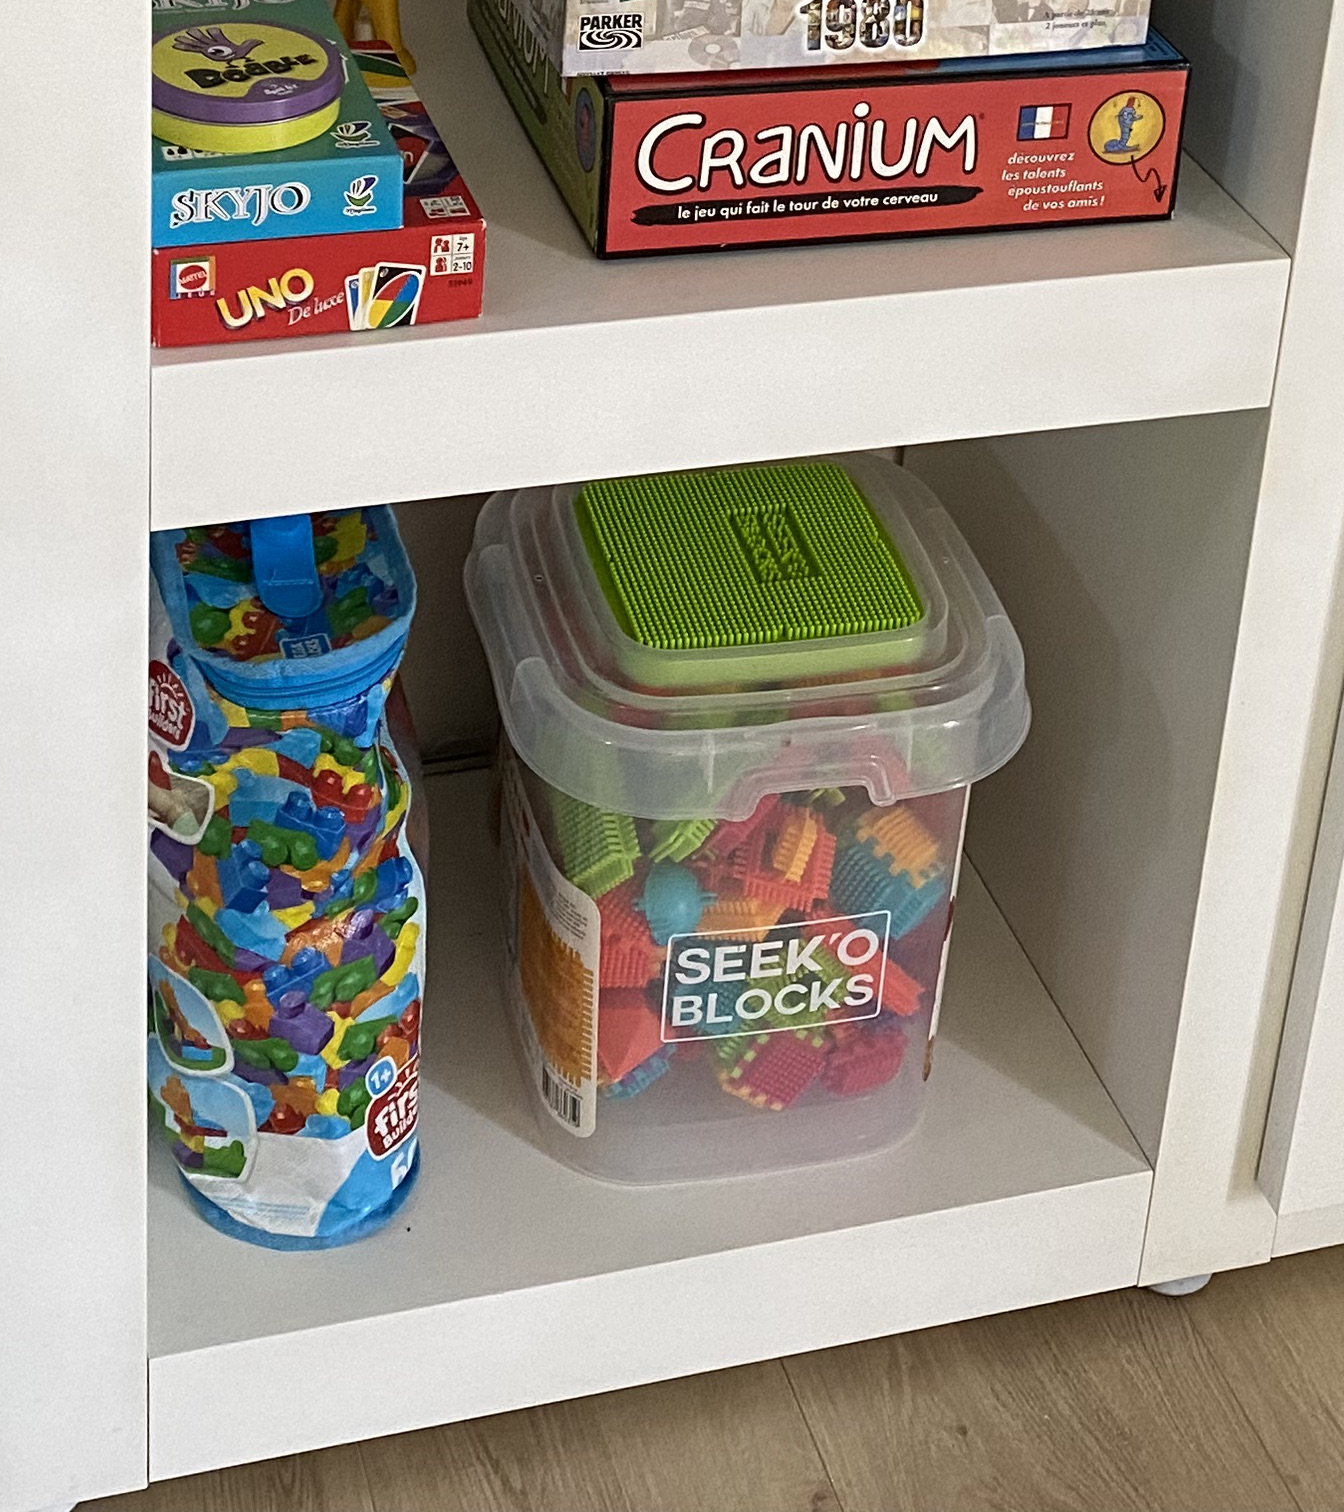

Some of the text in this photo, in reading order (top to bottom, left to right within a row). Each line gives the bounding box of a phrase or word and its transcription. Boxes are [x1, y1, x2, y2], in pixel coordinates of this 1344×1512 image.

[580, 13, 643, 31] PARKER
[1008, 151, 1076, 166] découvrez
[1001, 167, 1067, 182] les talents
[1008, 180, 1104, 199] époustouflants
[170, 182, 311, 228] SKYJO
[677, 191, 939, 222] le jeu qui fait le tour de votre cerveau
[1023, 198, 1040, 212] de
[1042, 198, 1065, 210] vos
[457, 242, 470, 252] 7+
[453, 261, 472, 272] 2-10
[216, 267, 315, 330] UNO
[674, 928, 880, 985] SEEK'O
[671, 972, 875, 1028] BLOCKS
